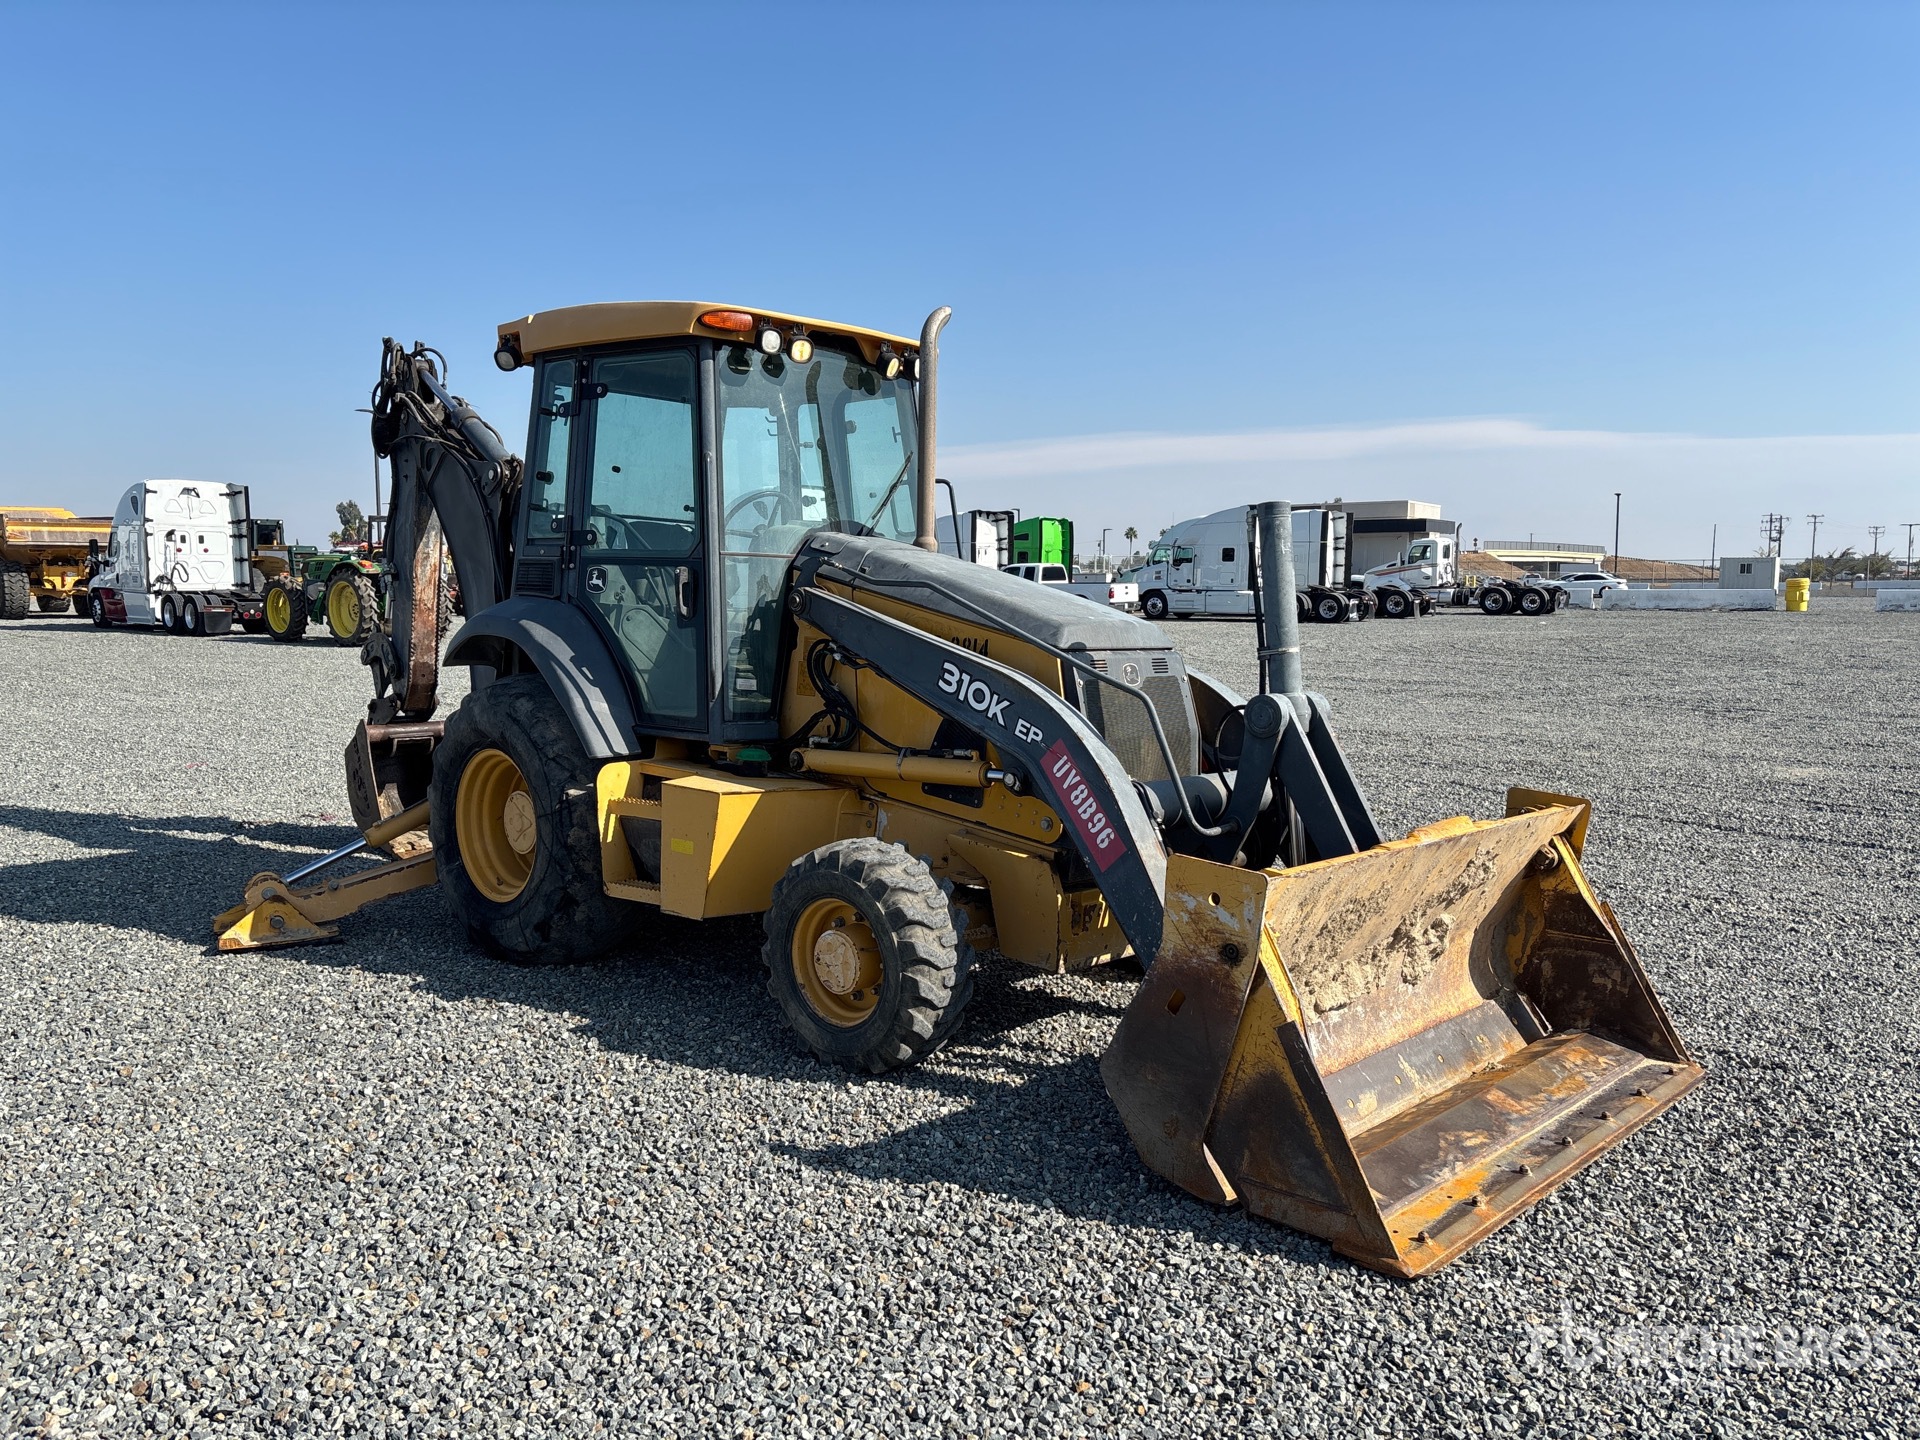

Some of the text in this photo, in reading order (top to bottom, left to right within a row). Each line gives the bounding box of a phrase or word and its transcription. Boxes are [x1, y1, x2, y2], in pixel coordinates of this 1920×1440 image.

[938, 661, 1043, 743] 310K EP
[1052, 755, 1115, 849] UV8B96
